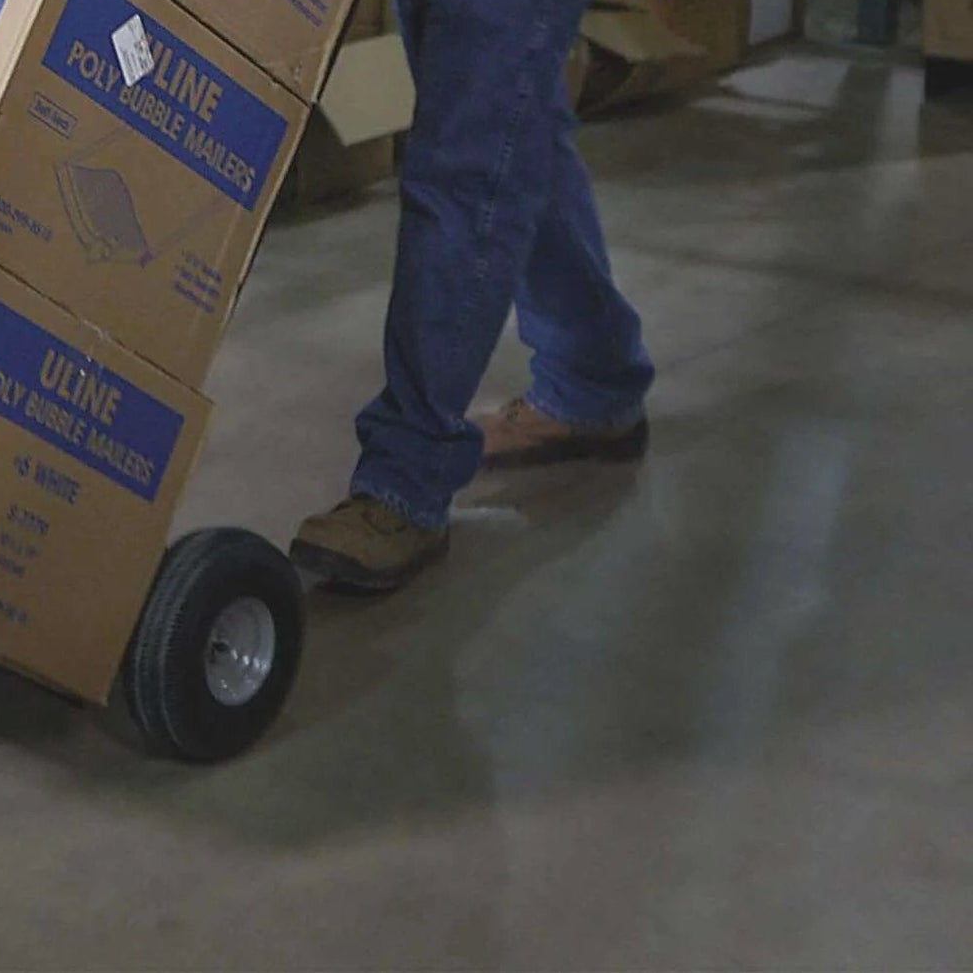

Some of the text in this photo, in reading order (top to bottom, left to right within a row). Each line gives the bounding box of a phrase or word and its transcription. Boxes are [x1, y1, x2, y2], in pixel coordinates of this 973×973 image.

[67, 40, 121, 93] POLY
[120, 85, 185, 141] BUBBLE
[184, 124, 256, 193] MAILERS
[39, 349, 123, 426] ULINE
[25, 390, 87, 445] BUBBLE
[86, 427, 155, 486] MAILERS
